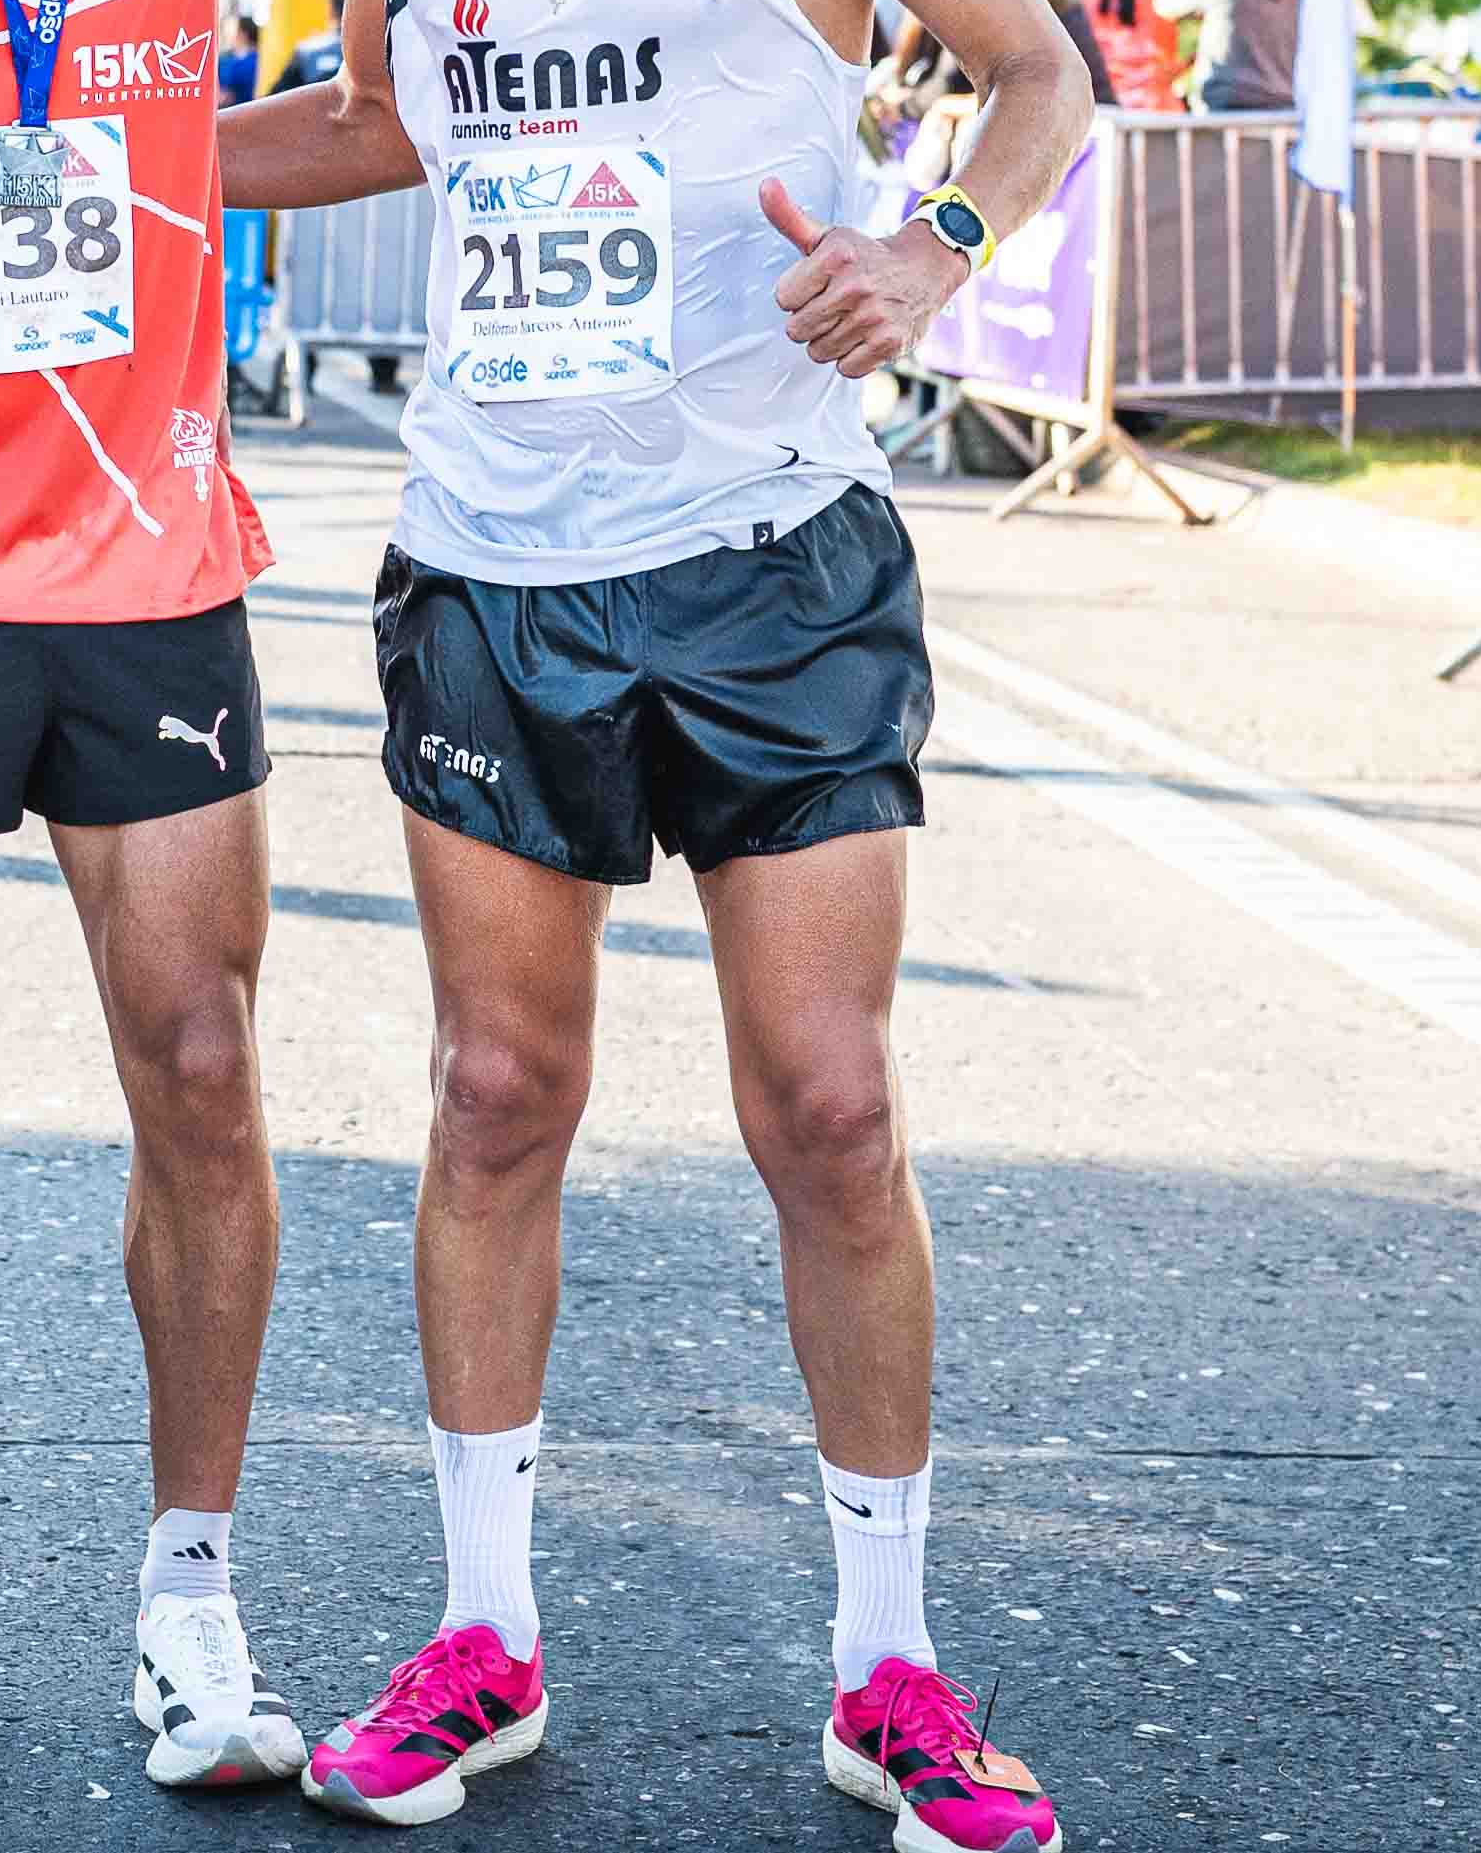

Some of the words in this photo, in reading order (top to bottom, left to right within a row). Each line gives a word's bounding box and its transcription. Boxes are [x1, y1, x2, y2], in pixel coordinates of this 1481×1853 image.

[73, 41, 153, 88] 15K
[444, 36, 662, 114] ATENAS
[451, 119, 512, 140] running
[519, 118, 578, 136] team
[463, 178, 507, 212] 15K
[586, 184, 624, 202] 15K
[460, 228, 658, 310] 2159
[472, 353, 528, 384] osde
